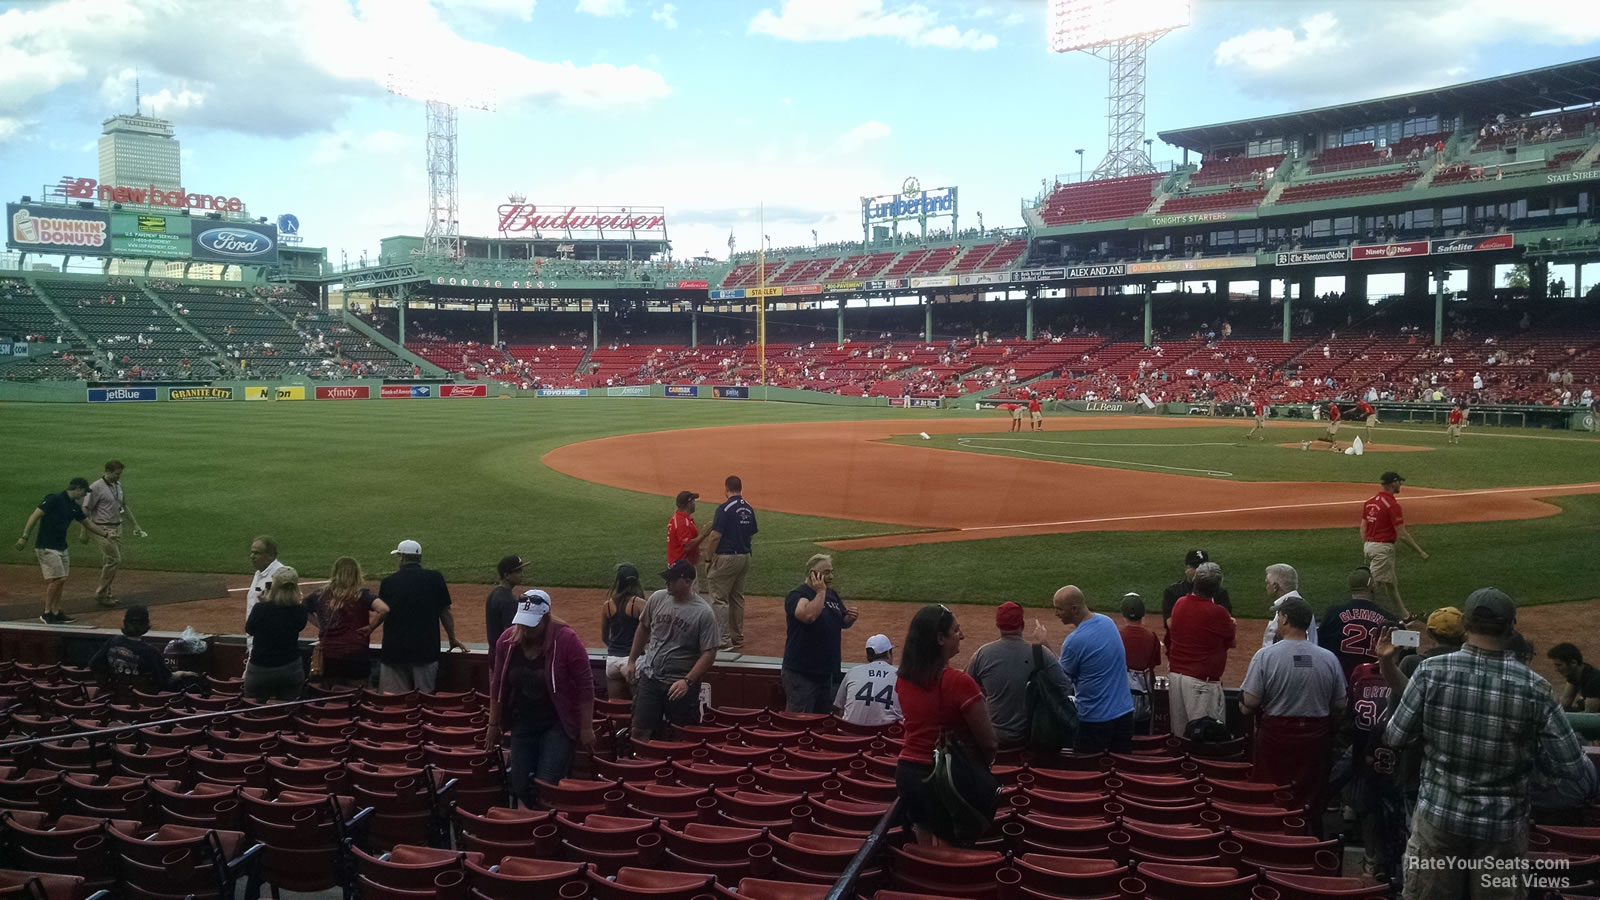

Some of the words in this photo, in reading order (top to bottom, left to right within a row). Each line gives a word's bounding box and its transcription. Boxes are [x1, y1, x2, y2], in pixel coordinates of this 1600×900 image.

[1547, 174, 1571, 183] STATE
[1572, 170, 1600, 181] STREE
[98, 184, 147, 204] new
[149, 184, 242, 212] balance
[497, 203, 665, 232] Budweiser
[1189, 212, 1227, 222] STARTERS
[40, 219, 106, 233] DUNKIN'
[40, 231, 104, 245] DONUTS
[213, 231, 257, 253] Ford
[1365, 248, 1385, 256] Ninety
[1437, 243, 1473, 253] Safelite
[1290, 254, 1302, 262] The
[1303, 252, 1326, 261] Boston
[1325, 250, 1346, 260] Globe
[1070, 268, 1089, 277] ALEX
[1090, 266, 1108, 276] AND
[1108, 265, 1124, 275] ANI
[106, 389, 140, 400] jetBlue
[171, 388, 210, 399] GRANITE
[211, 388, 231, 398] CITY
[328, 388, 358, 399] xfinity
[1341, 623, 1378, 658] 21
[868, 669, 889, 678] BAY
[855, 681, 894, 710] 44
